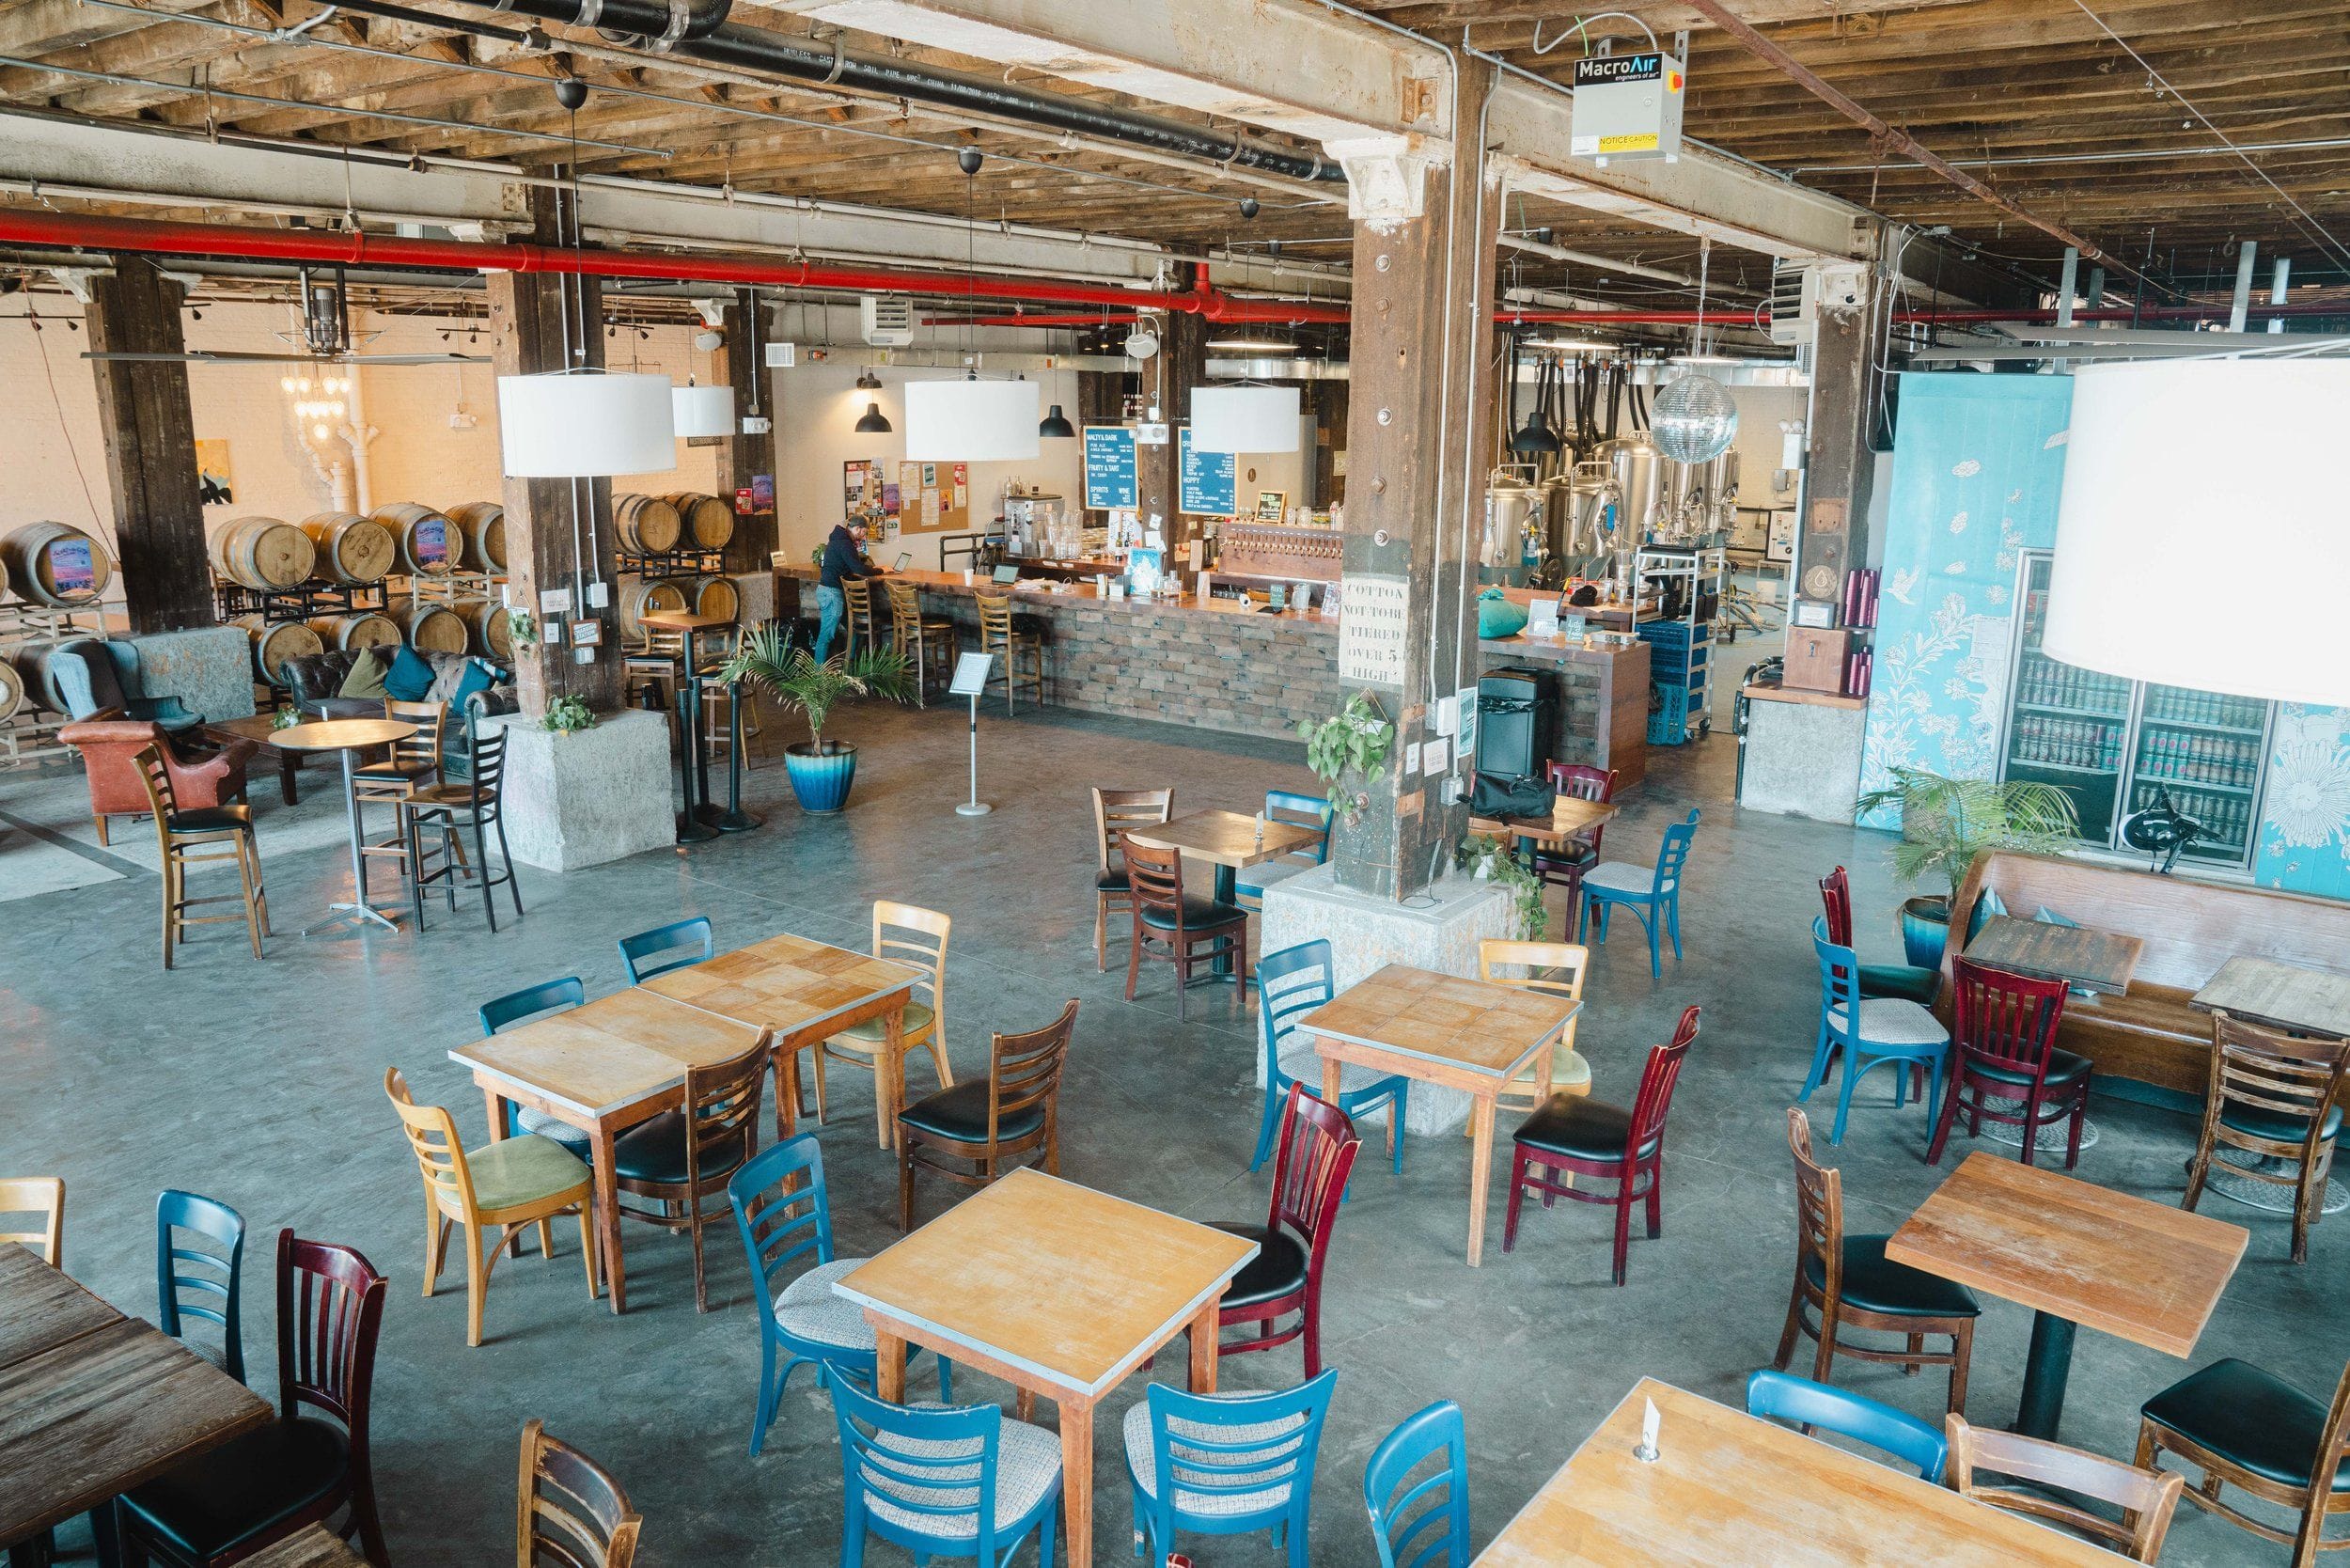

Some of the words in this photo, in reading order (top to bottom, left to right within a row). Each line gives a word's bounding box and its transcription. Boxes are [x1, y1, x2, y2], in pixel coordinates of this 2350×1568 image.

[1579, 56, 1657, 78] MacroAir
[863, 64, 879, 74] SOIL
[927, 78, 945, 89] CHINA
[1615, 73, 1641, 82] engineers
[1600, 136, 1628, 145] NOTICE
[1628, 134, 1657, 143] CAUTION
[1347, 584, 1402, 600] COTTON
[1349, 625, 1401, 640] TIERED
[1348, 648, 1382, 661] OVER
[1388, 649, 1397, 662] 5
[1353, 666, 1388, 682] HIGH
